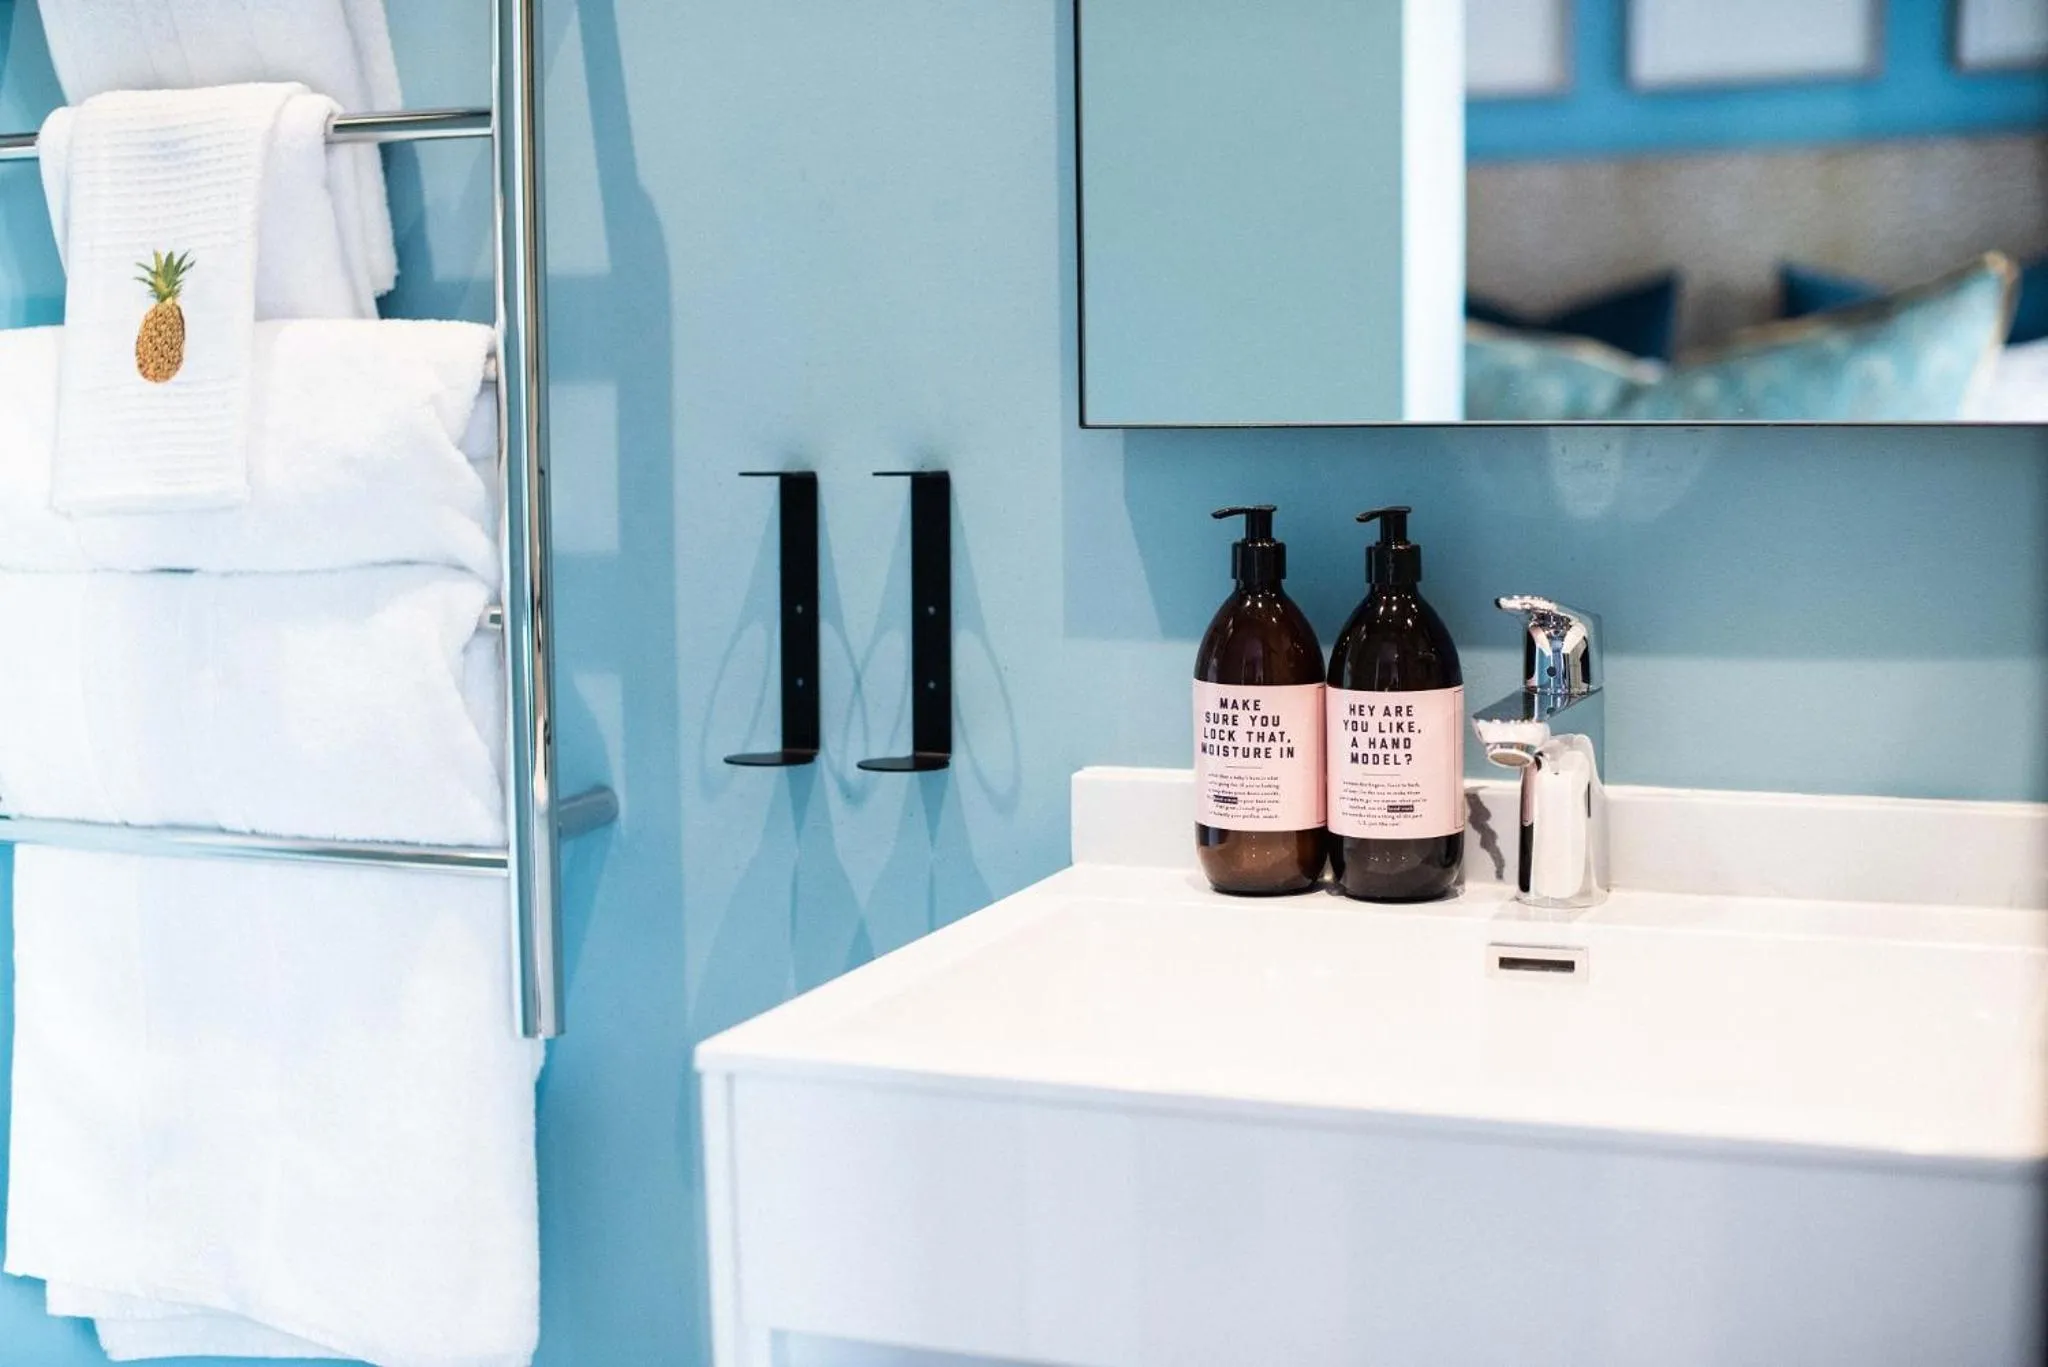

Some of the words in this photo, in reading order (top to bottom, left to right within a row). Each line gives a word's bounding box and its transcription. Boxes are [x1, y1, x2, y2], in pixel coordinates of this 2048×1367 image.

[1219, 697, 1261, 711] MAKE
[1349, 703, 1376, 717] HEY
[1383, 705, 1414, 717] ARE
[1205, 711, 1239, 726] SURE
[1249, 715, 1281, 727] YOU
[1343, 719, 1369, 733] YOU
[1203, 727, 1236, 742] LOCK
[1201, 741, 1272, 759] MOISTURE
[1279, 746, 1295, 759] IN
[1351, 736, 1359, 749] A
[1368, 737, 1412, 750] HAND
[1350, 752, 1413, 766] MODEL?
